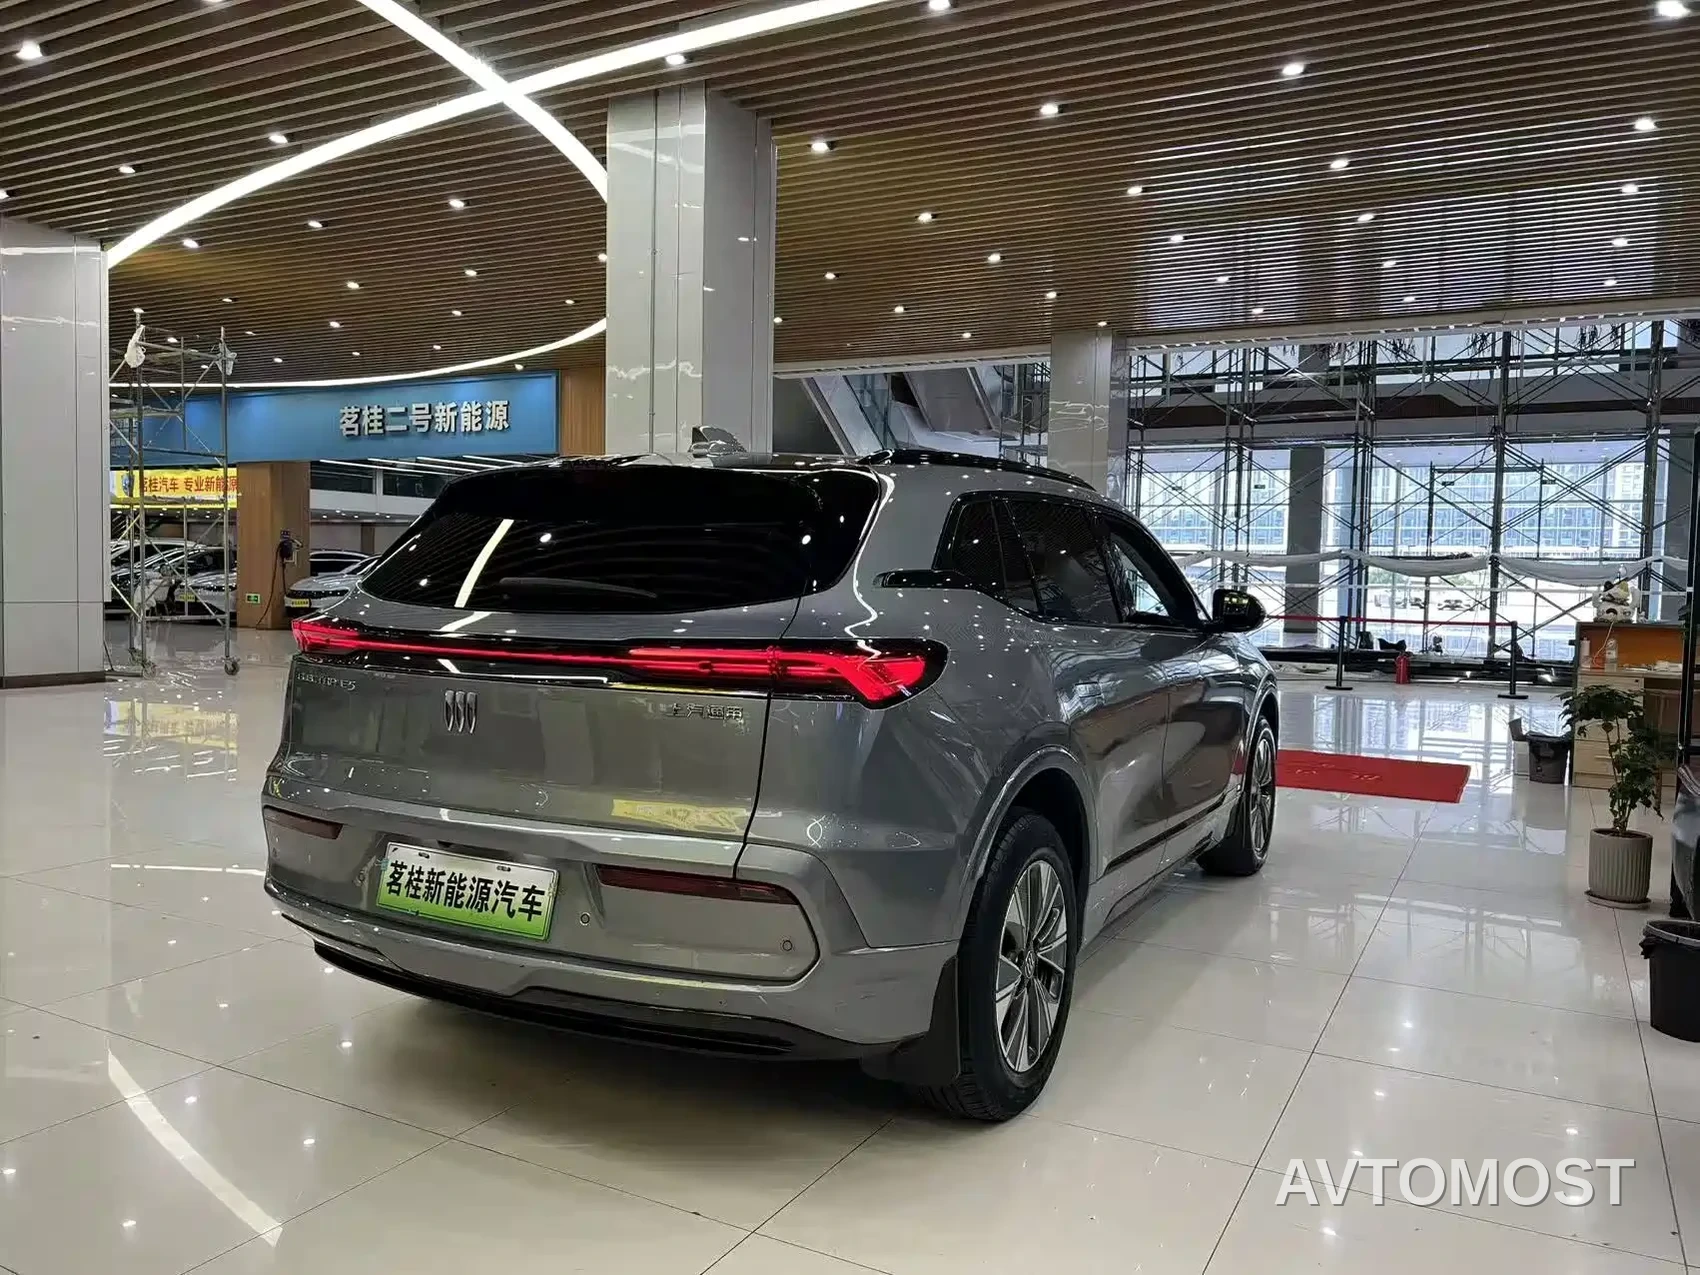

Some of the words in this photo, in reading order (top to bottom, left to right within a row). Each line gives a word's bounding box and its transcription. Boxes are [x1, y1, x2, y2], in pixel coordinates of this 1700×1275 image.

[340, 400, 509, 436] 茗桂二号新能源
[386, 860, 545, 922] 茗桂新能源汽车
